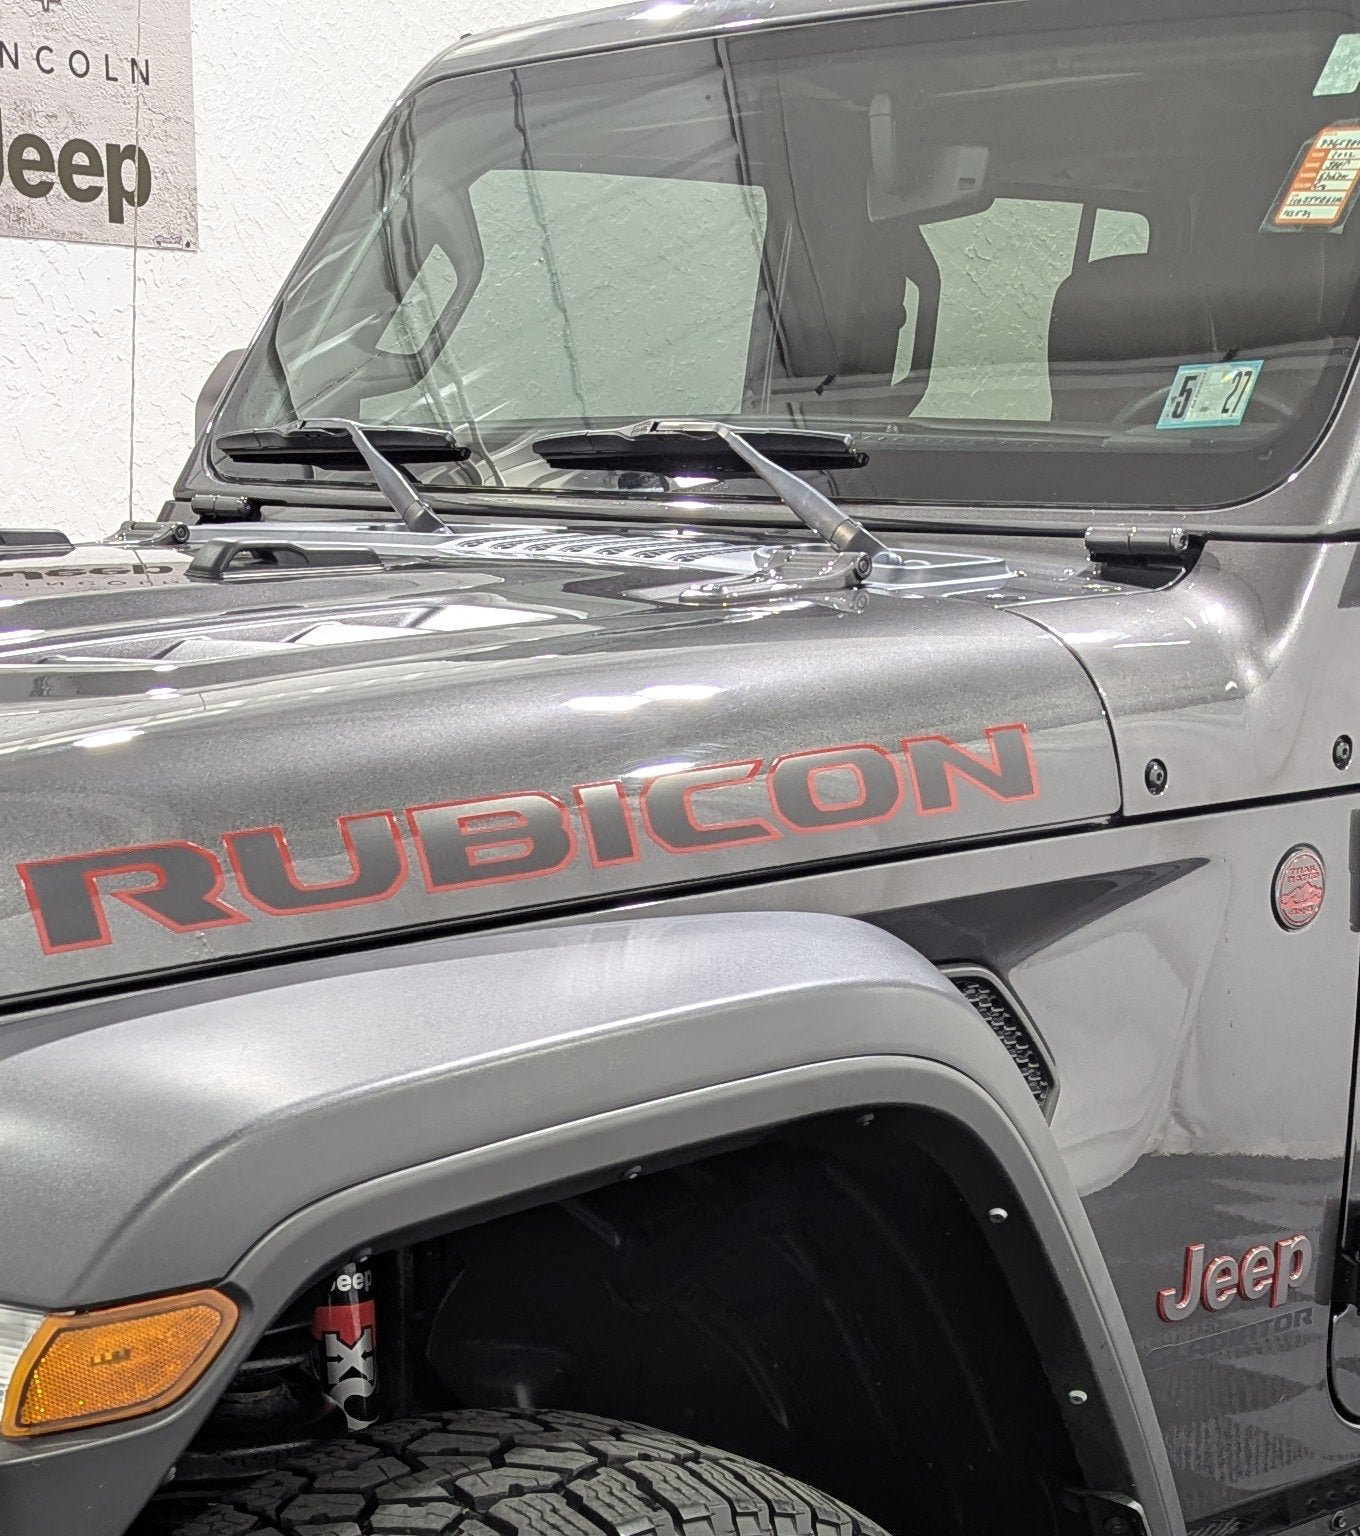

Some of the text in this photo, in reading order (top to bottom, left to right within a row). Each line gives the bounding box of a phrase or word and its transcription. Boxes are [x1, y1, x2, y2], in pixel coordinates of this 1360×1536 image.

[1171, 375, 1199, 419] 5
[1221, 370, 1253, 414] 27
[16, 723, 1038, 956] RUBICON
[1157, 1235, 1313, 1322] Jeep
